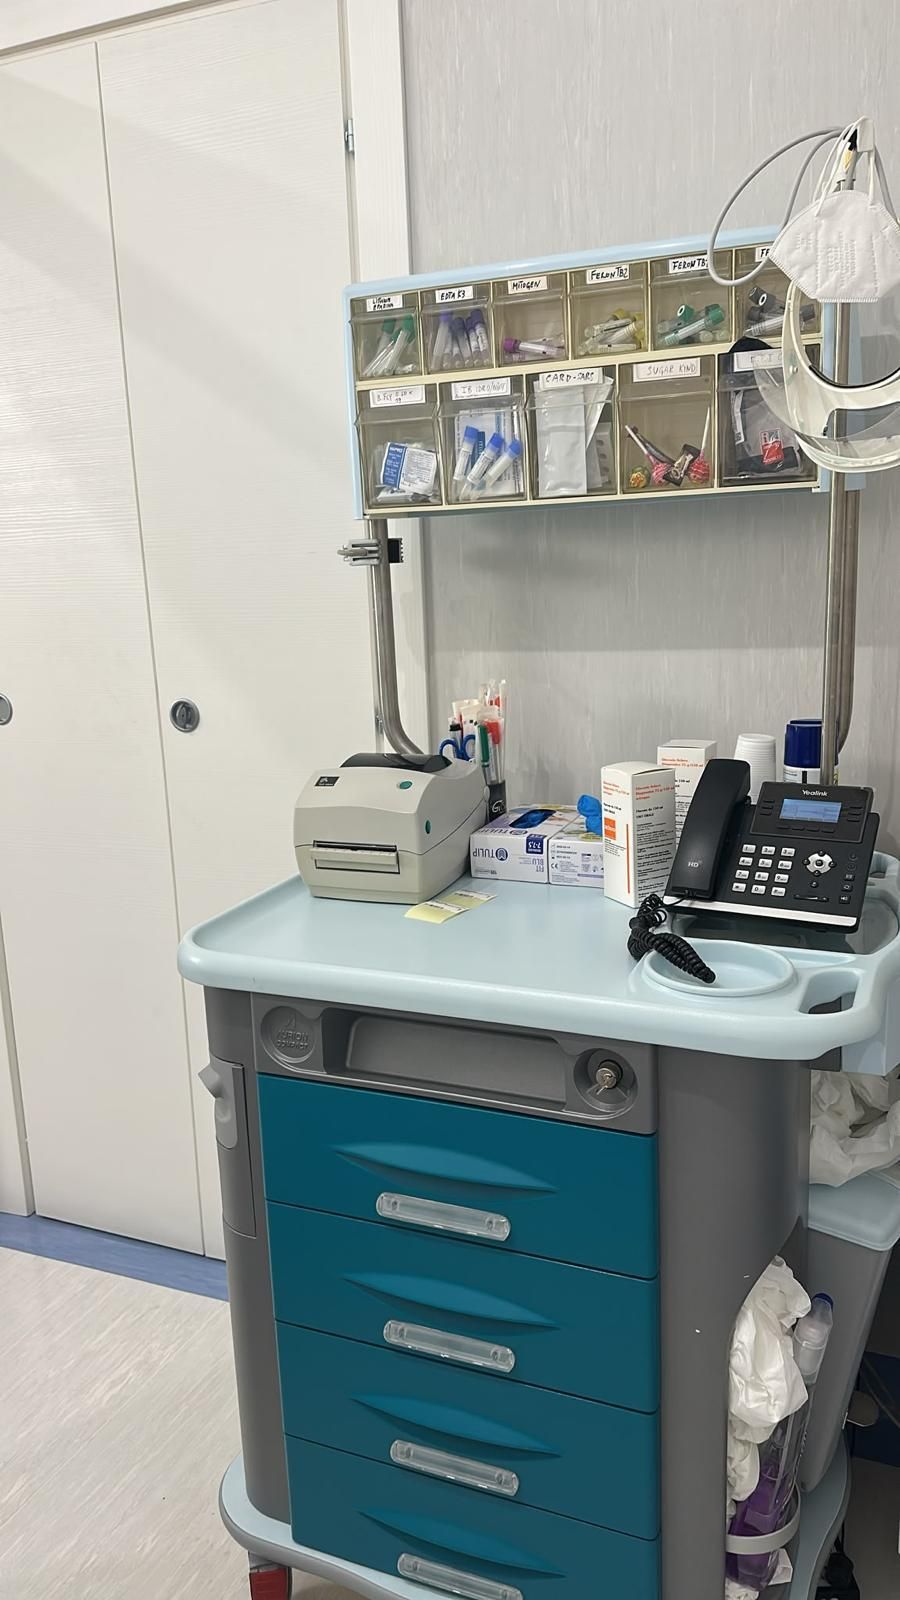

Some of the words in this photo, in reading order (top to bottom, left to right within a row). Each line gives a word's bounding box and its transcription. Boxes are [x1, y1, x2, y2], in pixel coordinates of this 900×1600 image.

[512, 280, 541, 290] MITOGEN
[440, 291, 456, 301] EDTA
[647, 364, 674, 376] SUGAR
[802, 789, 828, 797] Yealink
[472, 847, 495, 858] TULIP
